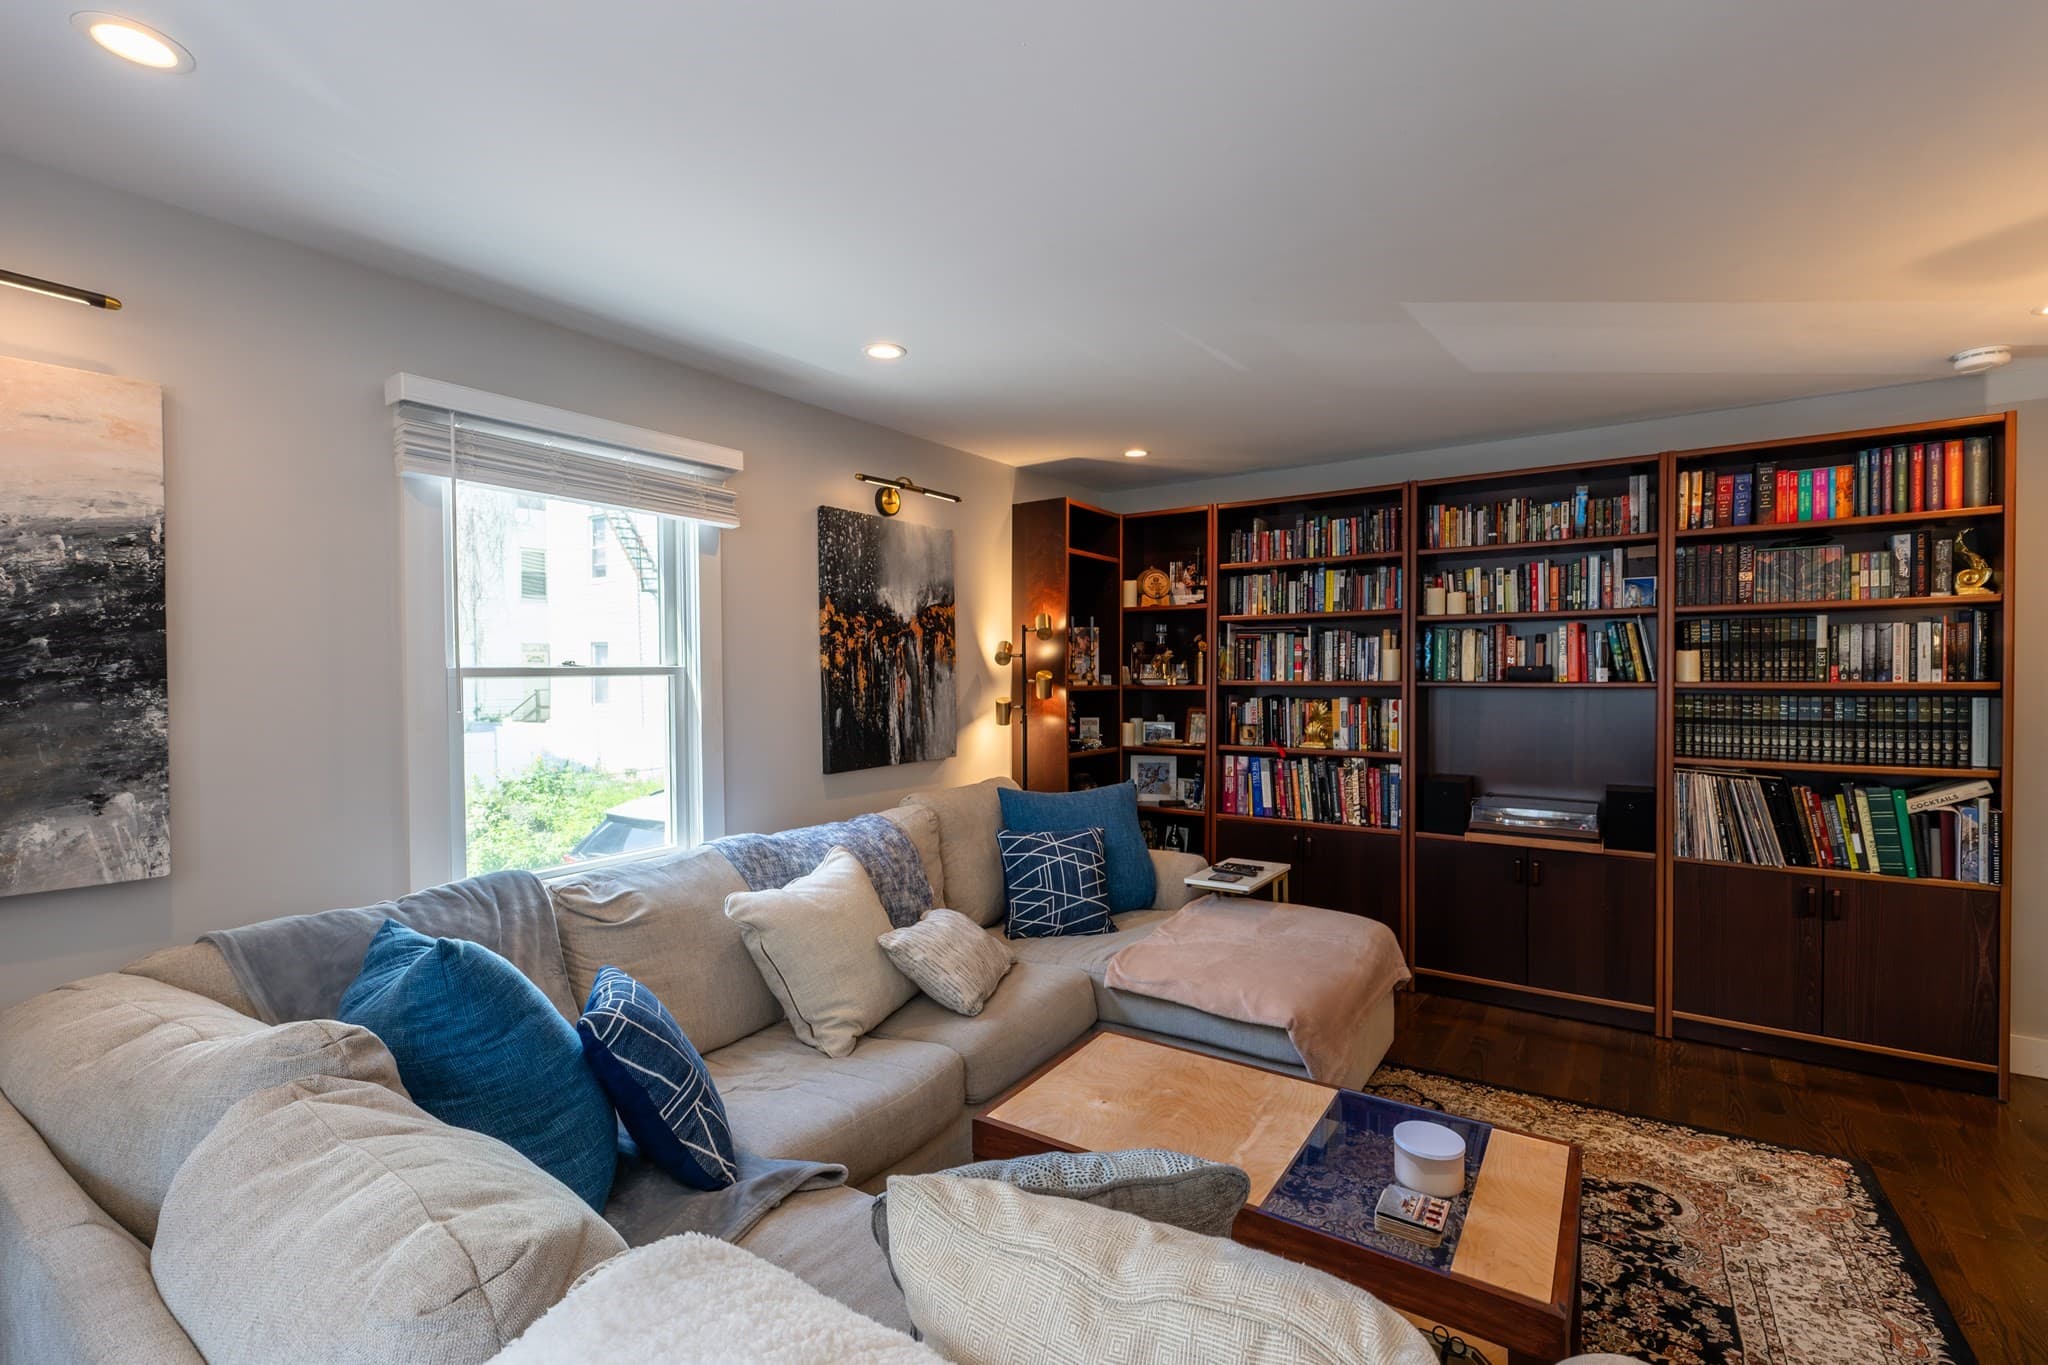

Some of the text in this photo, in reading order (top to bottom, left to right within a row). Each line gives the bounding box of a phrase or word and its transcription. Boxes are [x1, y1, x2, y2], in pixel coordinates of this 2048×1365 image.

[1559, 627, 1567, 639] LEE
[1817, 651, 1826, 667] 1873
[1910, 794, 1959, 810] COCKTAILS
